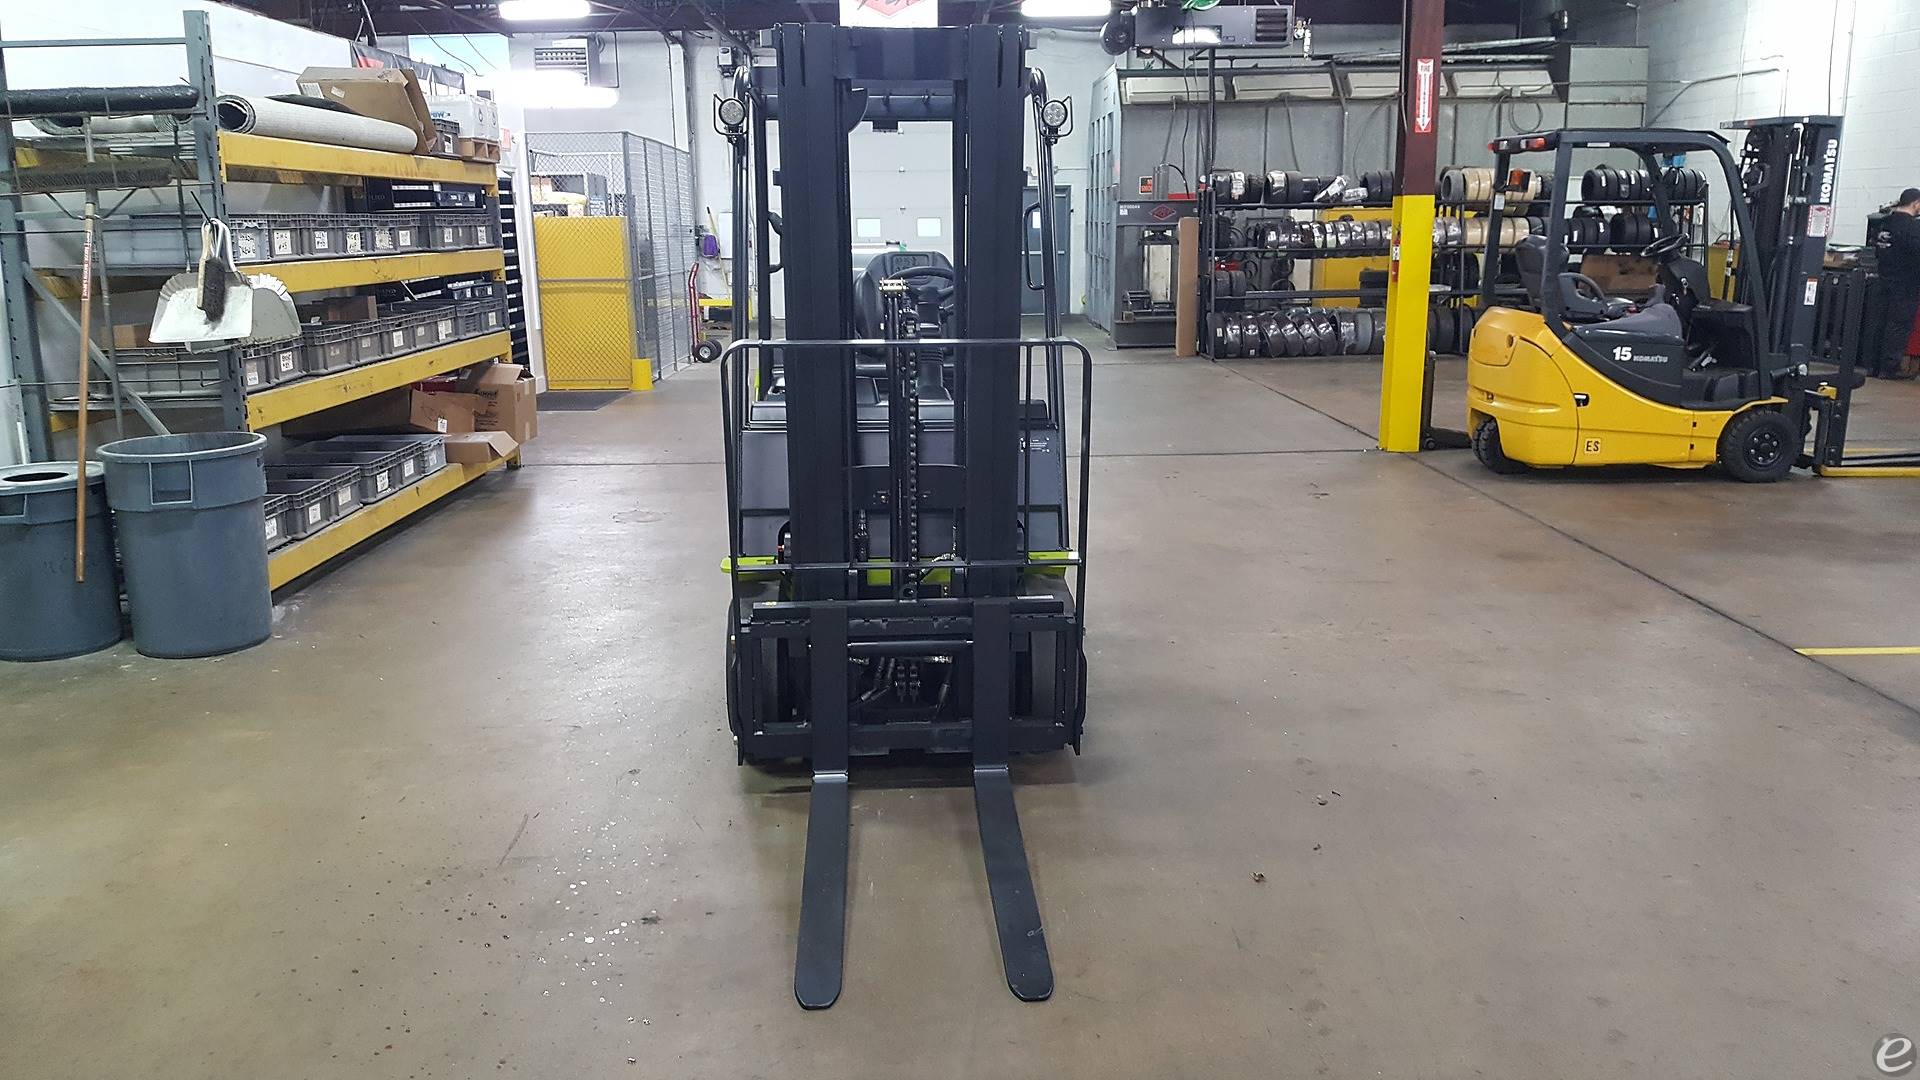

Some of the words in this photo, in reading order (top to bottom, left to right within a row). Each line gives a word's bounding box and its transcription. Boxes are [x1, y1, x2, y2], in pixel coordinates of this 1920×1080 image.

[1820, 139, 1838, 203] KOMATSU
[1612, 346, 1632, 361] 15
[1633, 355, 1669, 363] KOMATSU
[1586, 440, 1600, 452] ES
